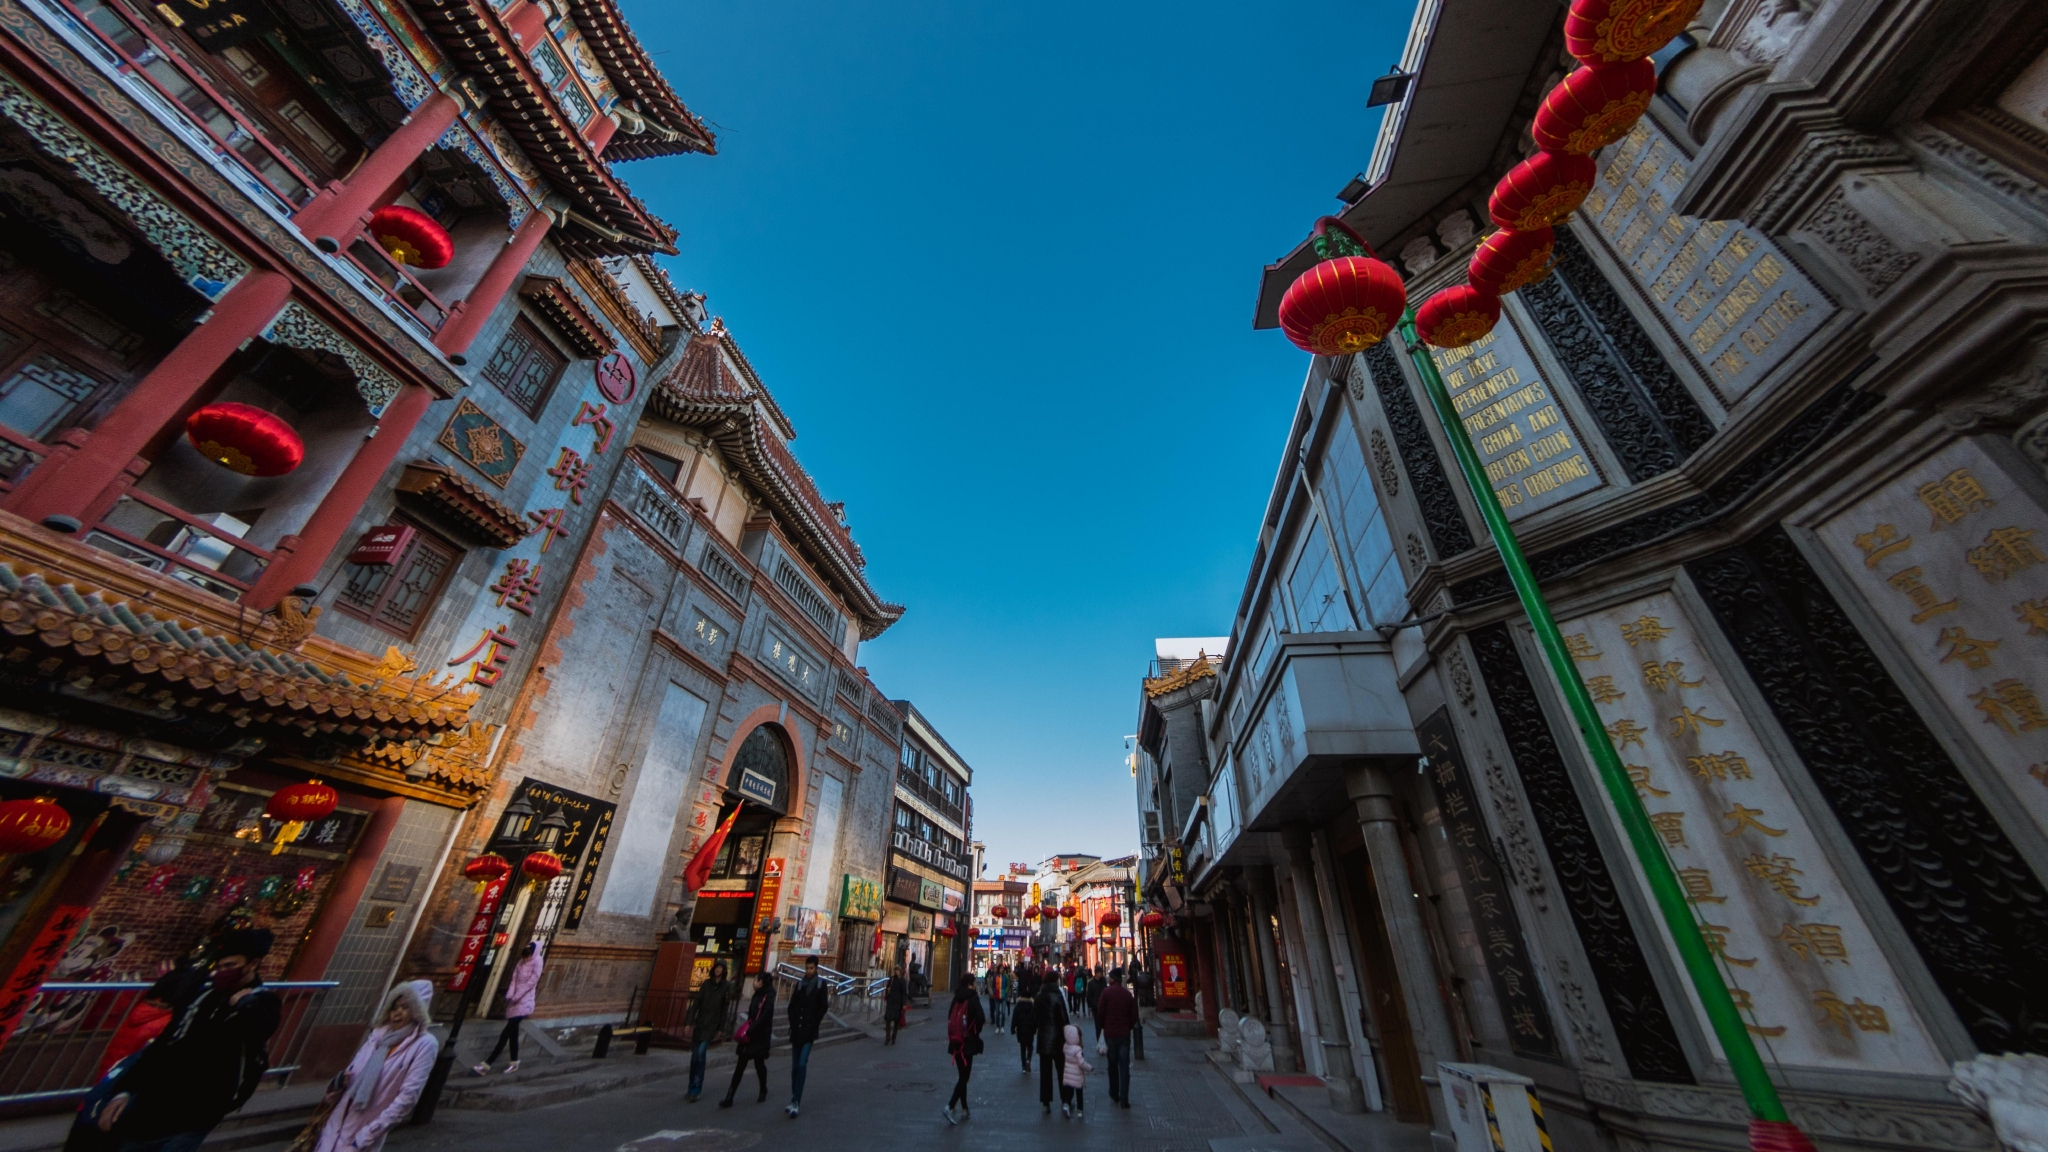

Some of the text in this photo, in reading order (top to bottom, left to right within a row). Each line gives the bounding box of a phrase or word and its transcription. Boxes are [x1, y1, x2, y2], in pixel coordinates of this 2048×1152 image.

[1446, 349, 1500, 389] WE HAVE
[1462, 381, 1546, 437] PRESENTATIVES
[1481, 405, 1559, 455] CHINA AND
[1483, 447, 1532, 485] OREIGN
[1494, 454, 1590, 509] RIES ORDERING
[448, 400, 617, 688] 内联升鞋店
[1171, 847, 1185, 884] 稻香村
